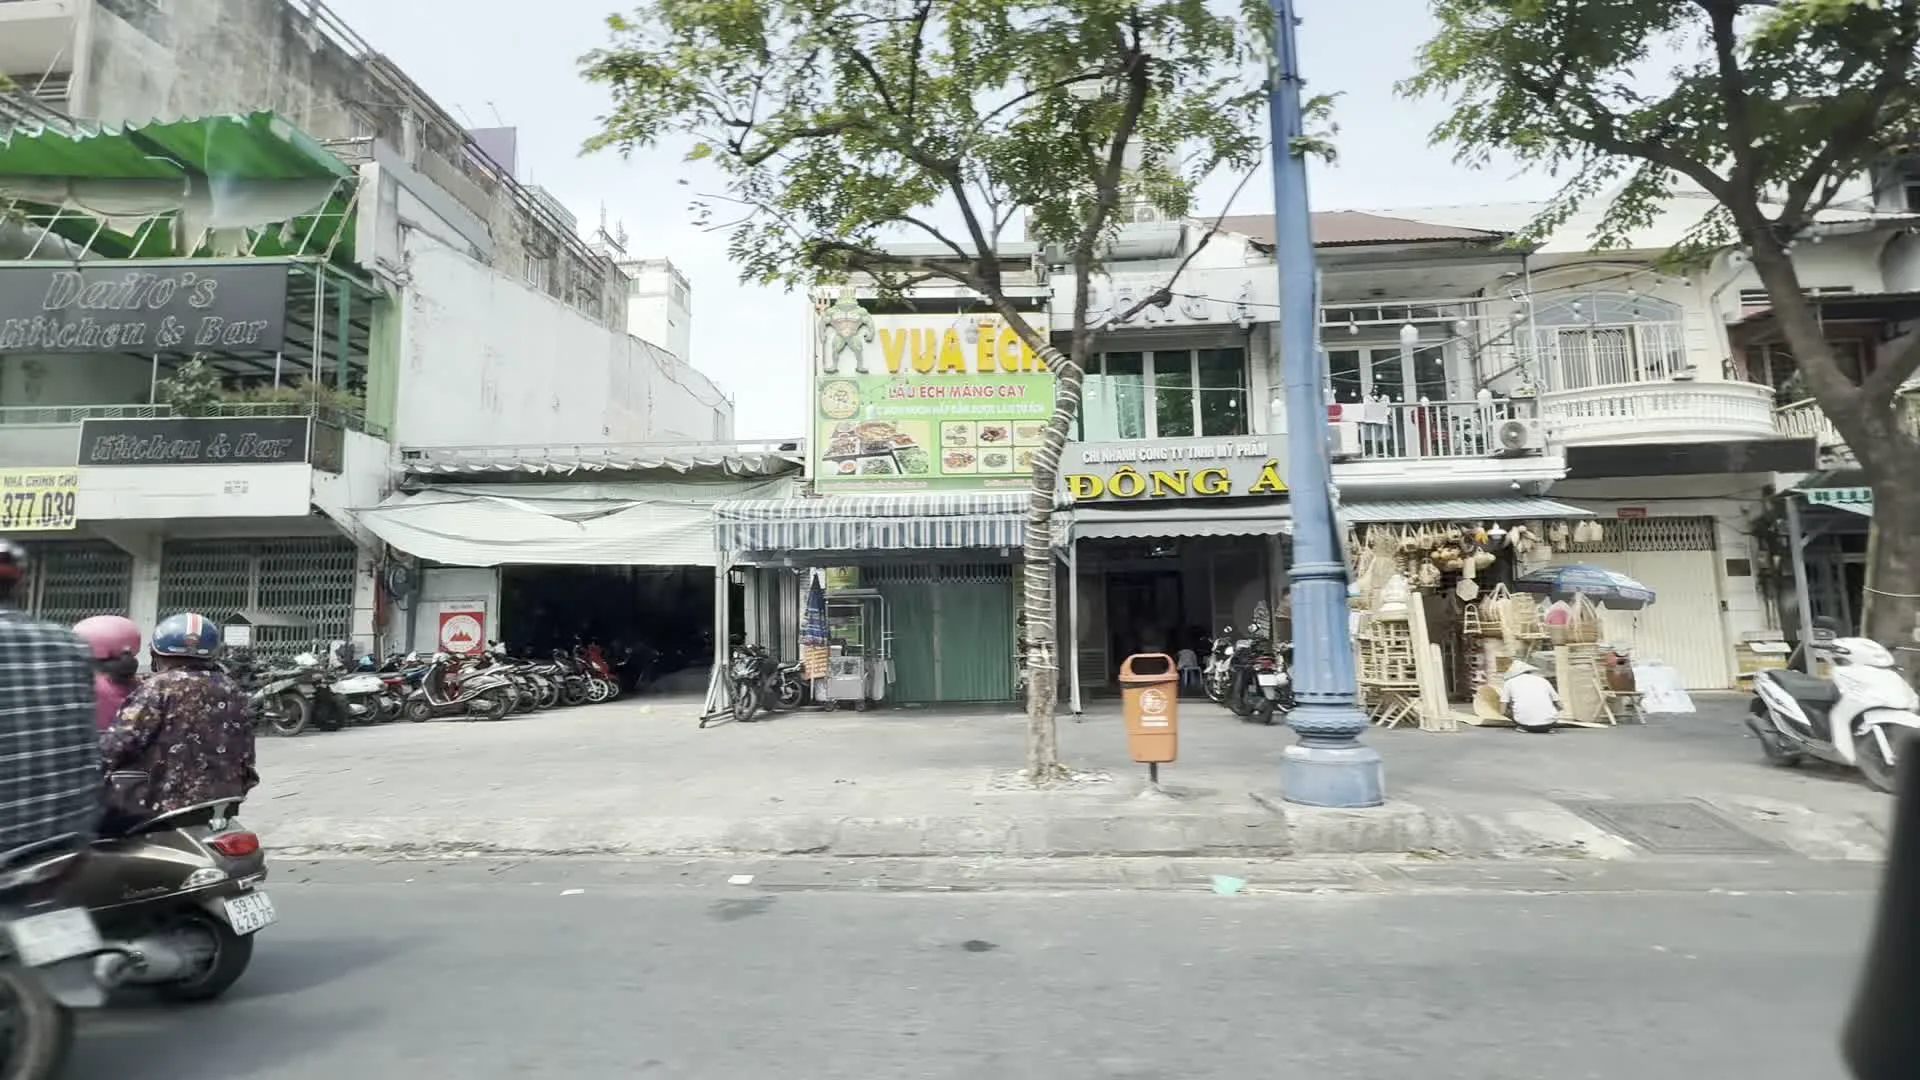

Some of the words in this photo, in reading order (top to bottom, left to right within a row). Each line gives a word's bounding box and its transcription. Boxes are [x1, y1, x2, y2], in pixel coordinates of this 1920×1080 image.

[156, 315, 185, 347] &
[194, 316, 268, 346] Bar
[879, 327, 966, 374] VUA
[206, 432, 231, 458] &
[1168, 447, 1183, 460] TY
[1064, 463, 1233, 500] ĐÔNG
[1247, 456, 1289, 494] Á
